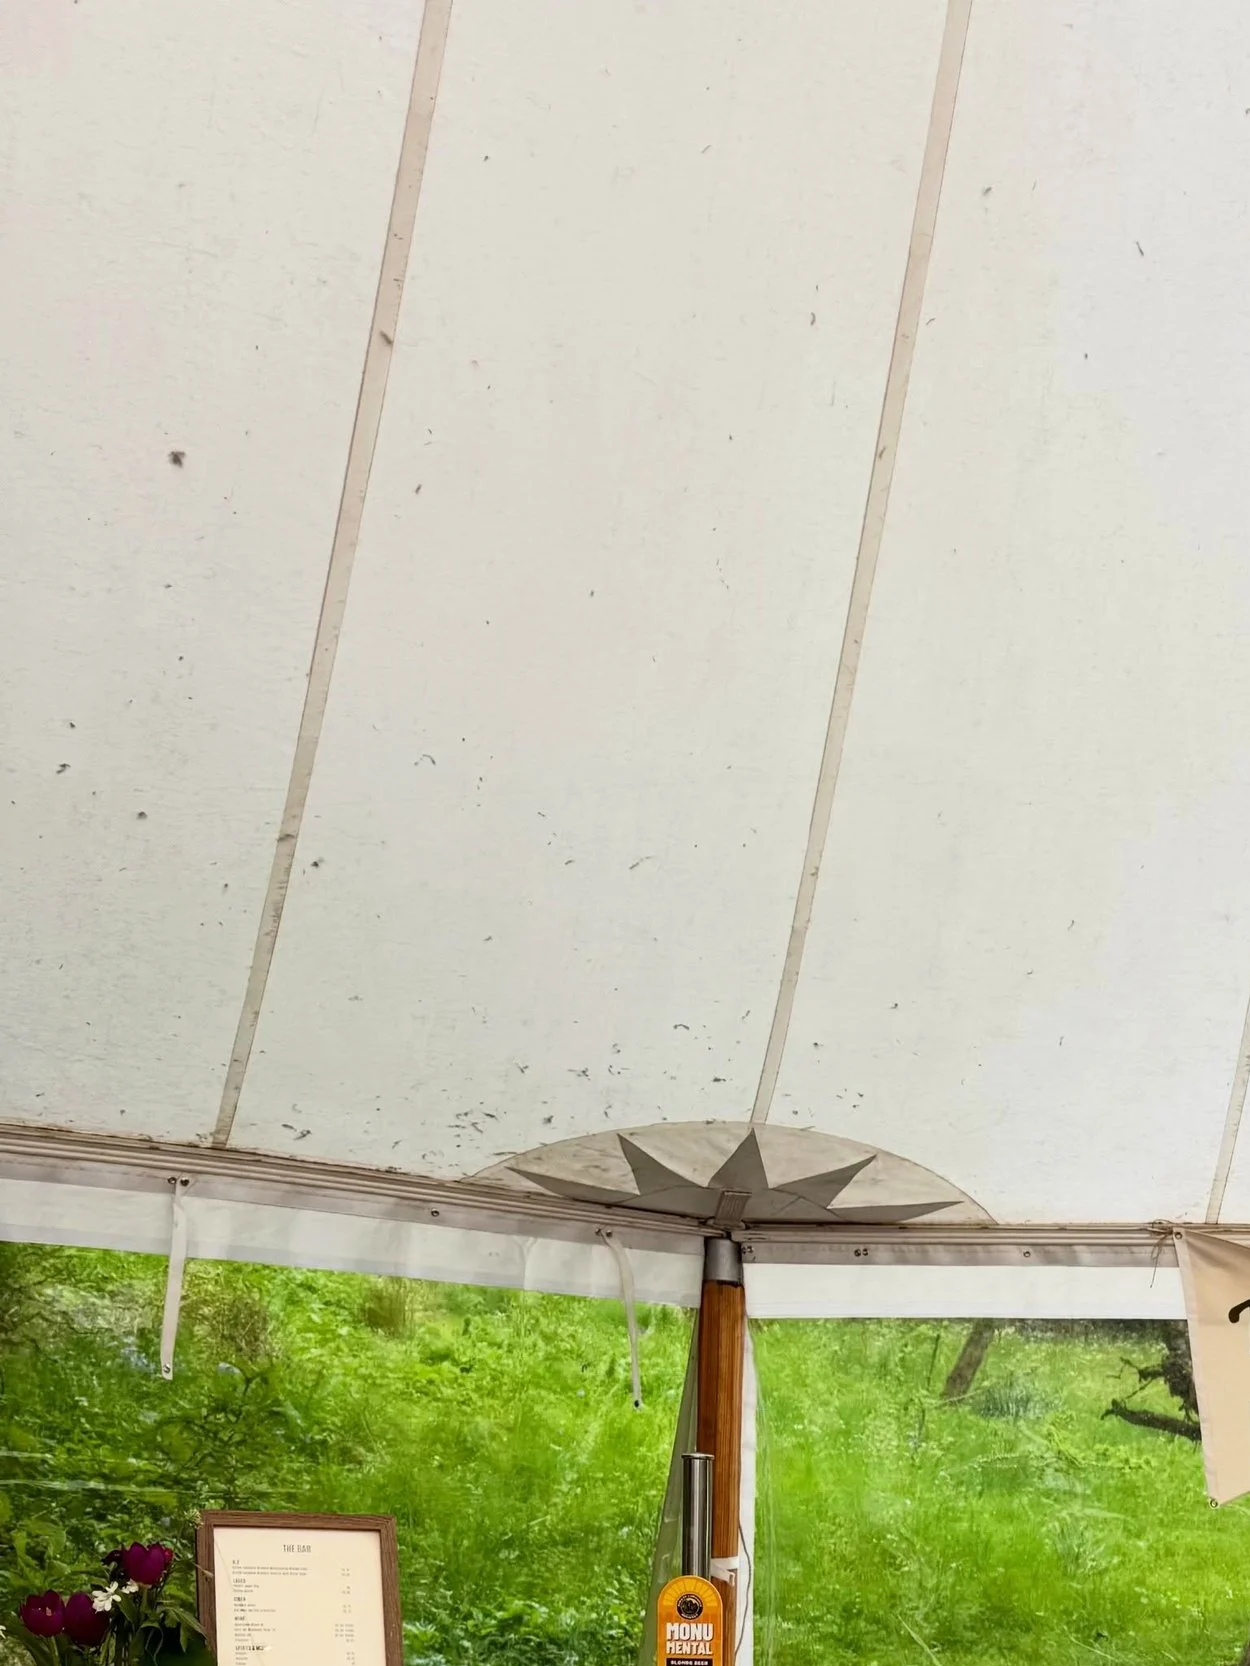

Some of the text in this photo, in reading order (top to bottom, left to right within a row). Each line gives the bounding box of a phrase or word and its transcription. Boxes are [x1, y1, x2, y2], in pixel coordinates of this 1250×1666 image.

[283, 1544, 295, 1553] THE
[666, 1622, 714, 1641] MONU
[666, 1641, 713, 1656] MENTAL
